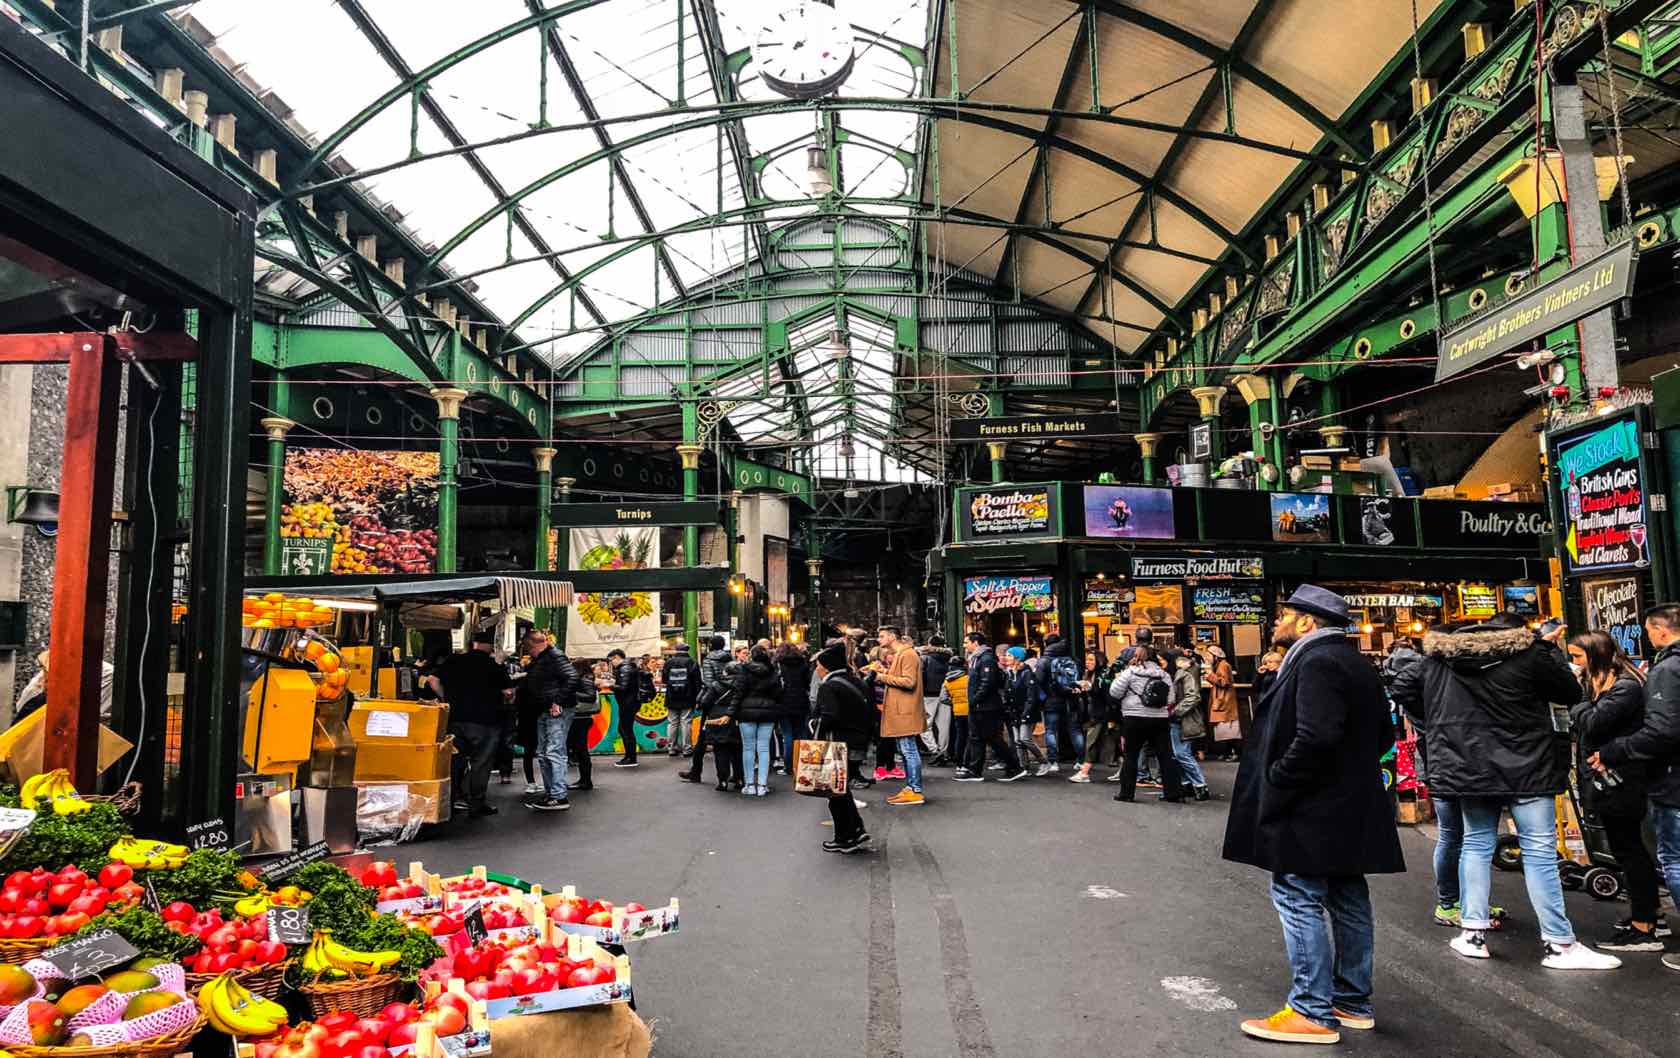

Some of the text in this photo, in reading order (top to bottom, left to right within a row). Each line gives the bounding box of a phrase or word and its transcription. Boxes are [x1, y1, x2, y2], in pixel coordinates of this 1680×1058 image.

[1450, 264, 1614, 361] Cartwright Brothers Vintners Ltd
[980, 421, 1086, 435] Furness Fish Markets
[1566, 431, 1624, 473] We Stock
[1581, 467, 1637, 494] British Gins
[980, 491, 1033, 506] Bomba
[615, 508, 652, 520] Turnips
[979, 504, 1026, 519] Paella
[1460, 510, 1514, 536] Poultry
[283, 538, 327, 547] TURNIPS
[1595, 545, 1629, 563] Clarets
[1133, 558, 1241, 576] Furness Food Hut
[971, 580, 996, 593] Salt
[1009, 579, 1046, 593] Pepper
[1195, 588, 1231, 598] FRESH
[968, 590, 1023, 614] Squid
[1343, 594, 1387, 606] OYSTER
[1597, 582, 1637, 609] Chocolate
[268, 908, 280, 943] NANAS
